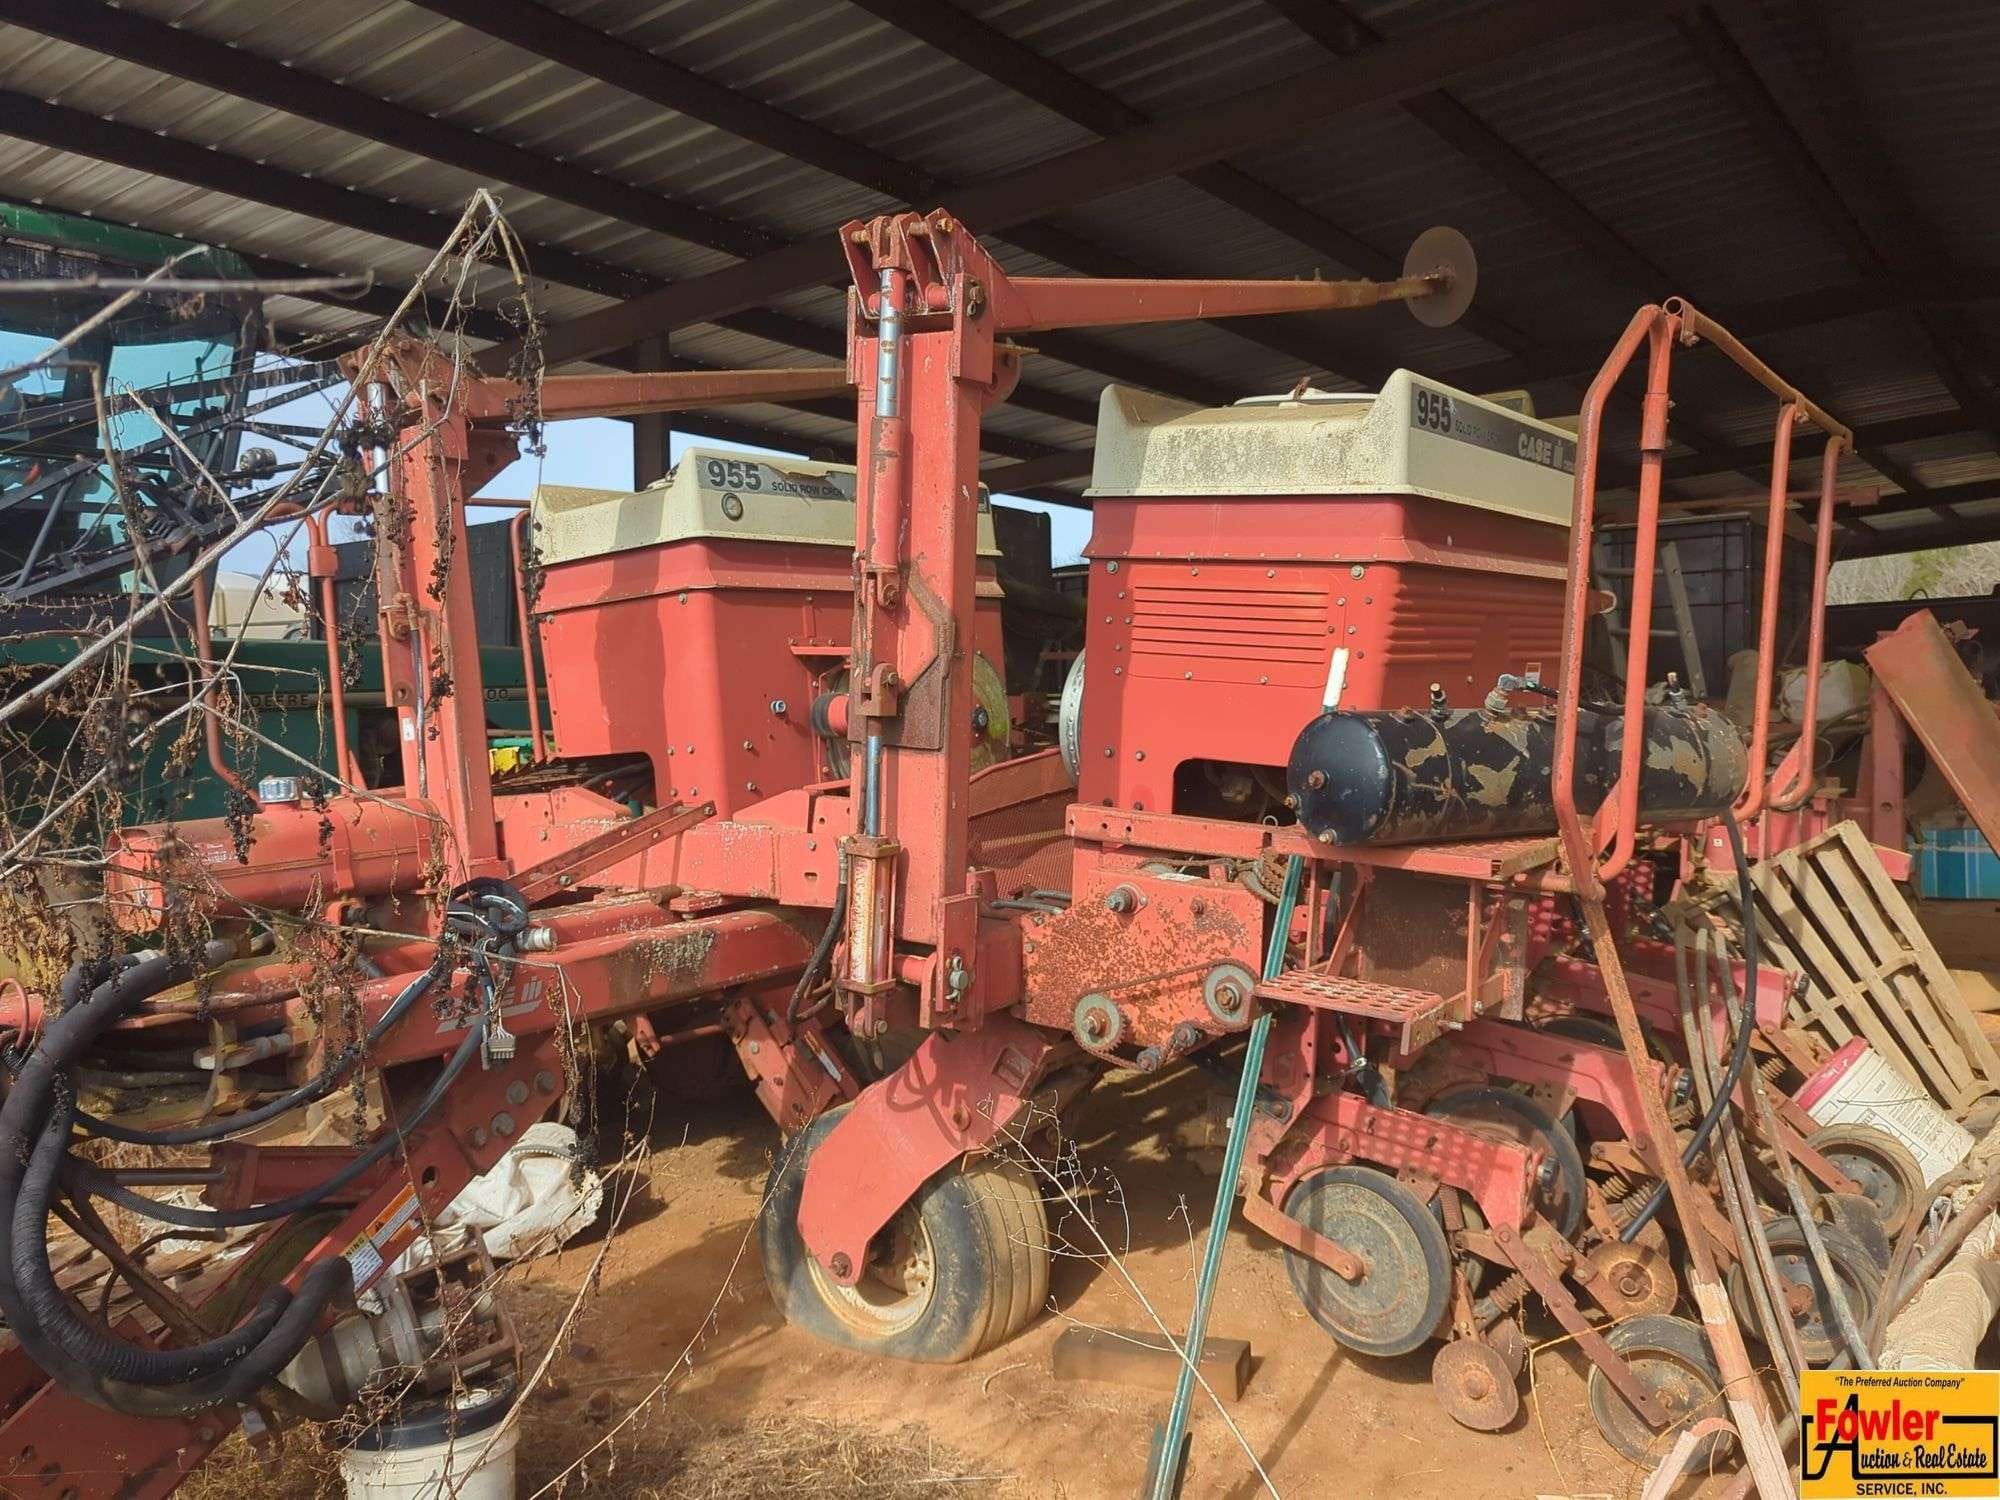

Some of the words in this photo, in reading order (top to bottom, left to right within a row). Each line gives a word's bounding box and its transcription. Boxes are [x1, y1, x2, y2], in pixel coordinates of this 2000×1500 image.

[1418, 390, 1451, 433] 955
[1518, 432, 1552, 465] CASE
[708, 459, 762, 491] 955
[771, 481, 798, 493] SOLID
[251, 694, 309, 707] DEERE
